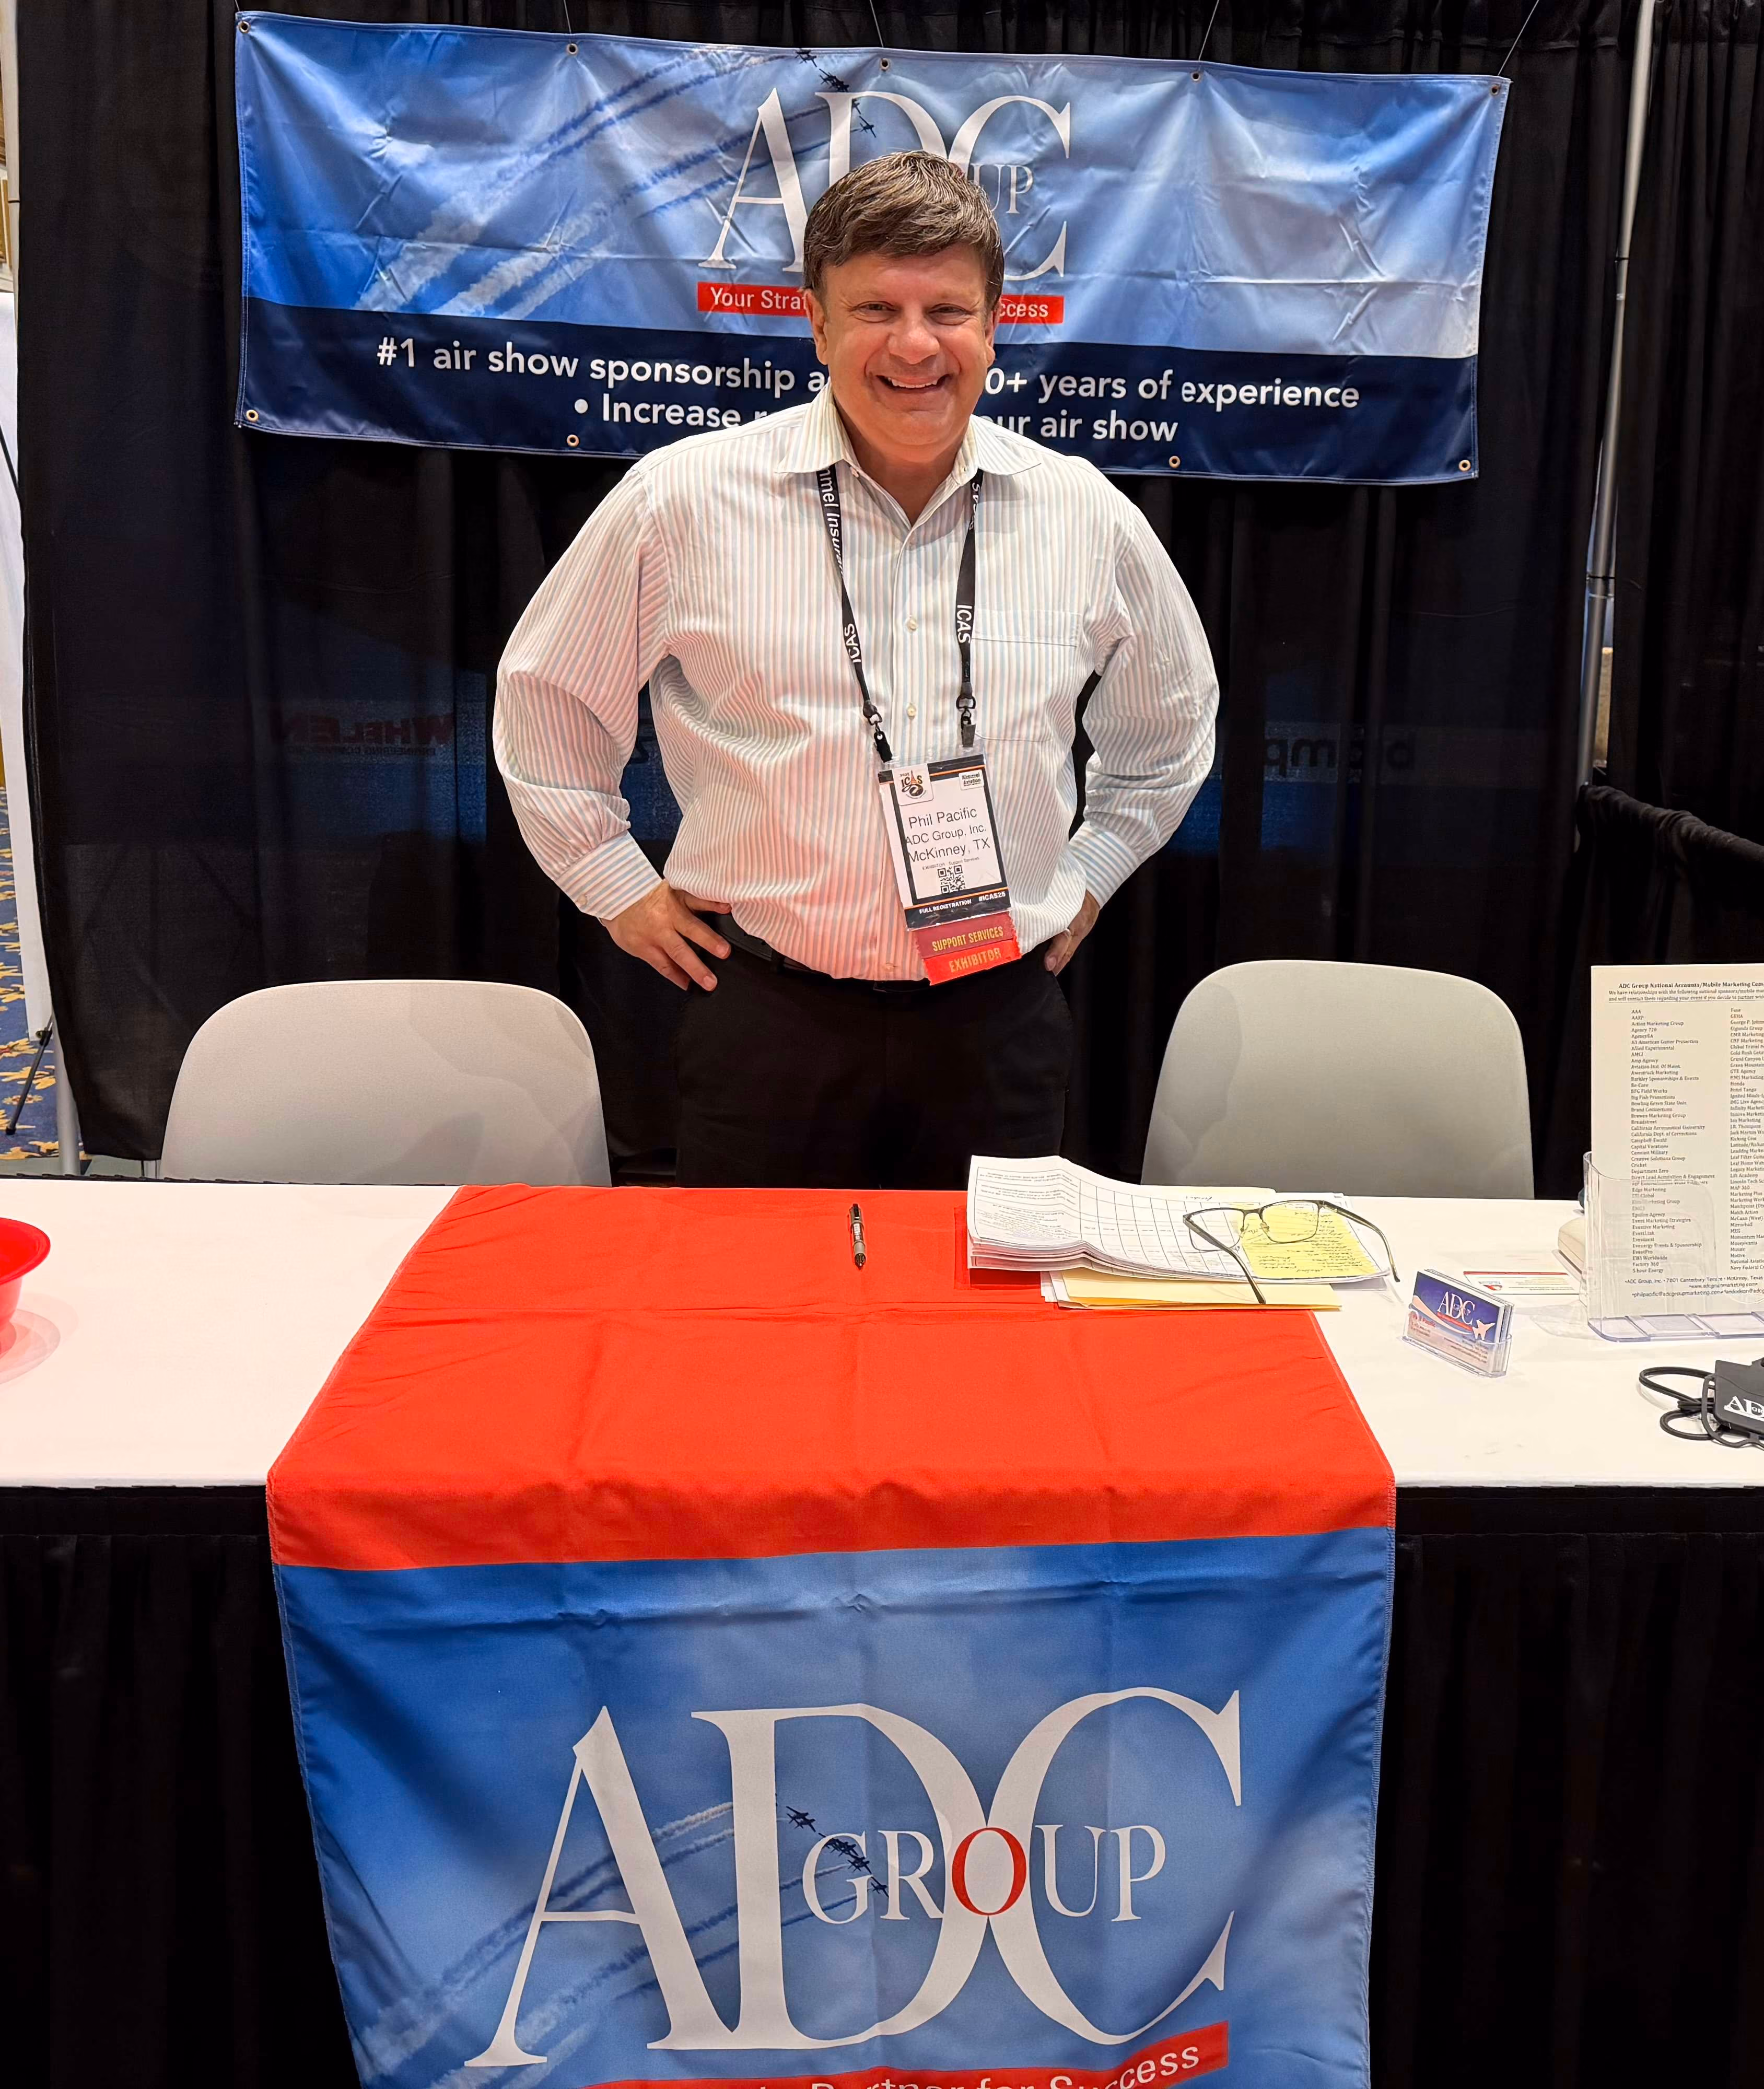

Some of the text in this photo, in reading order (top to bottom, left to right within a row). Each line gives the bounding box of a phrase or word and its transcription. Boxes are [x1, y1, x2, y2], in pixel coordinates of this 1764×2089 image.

[710, 287, 754, 307] Your
[377, 337, 416, 367] #1
[434, 340, 476, 370] air
[488, 342, 578, 377] show
[590, 357, 796, 398] sponsorship
[1038, 372, 1126, 404] years
[1138, 369, 1173, 399] of
[1183, 378, 1359, 412] experience
[603, 394, 741, 427] Increase
[1040, 409, 1083, 438] air
[1093, 410, 1178, 442] show
[957, 604, 972, 644] ICAS
[844, 623, 861, 663] ICAS
[909, 807, 977, 829] Phil Pacific
[905, 825, 987, 845] ADC Group, Inc.
[908, 837, 990, 862] McKinney, TX
[933, 898, 972, 911] REGISTRATION
[978, 892, 1006, 902] #ICAS25
[932, 926, 1003, 951] SUPPORT SERVICES
[948, 948, 1002, 973] EXHIBITOR
[1437, 1291, 1475, 1326] ADC
[464, 1686, 1241, 2068] ADC
[802, 1824, 1166, 1924] GROUP
